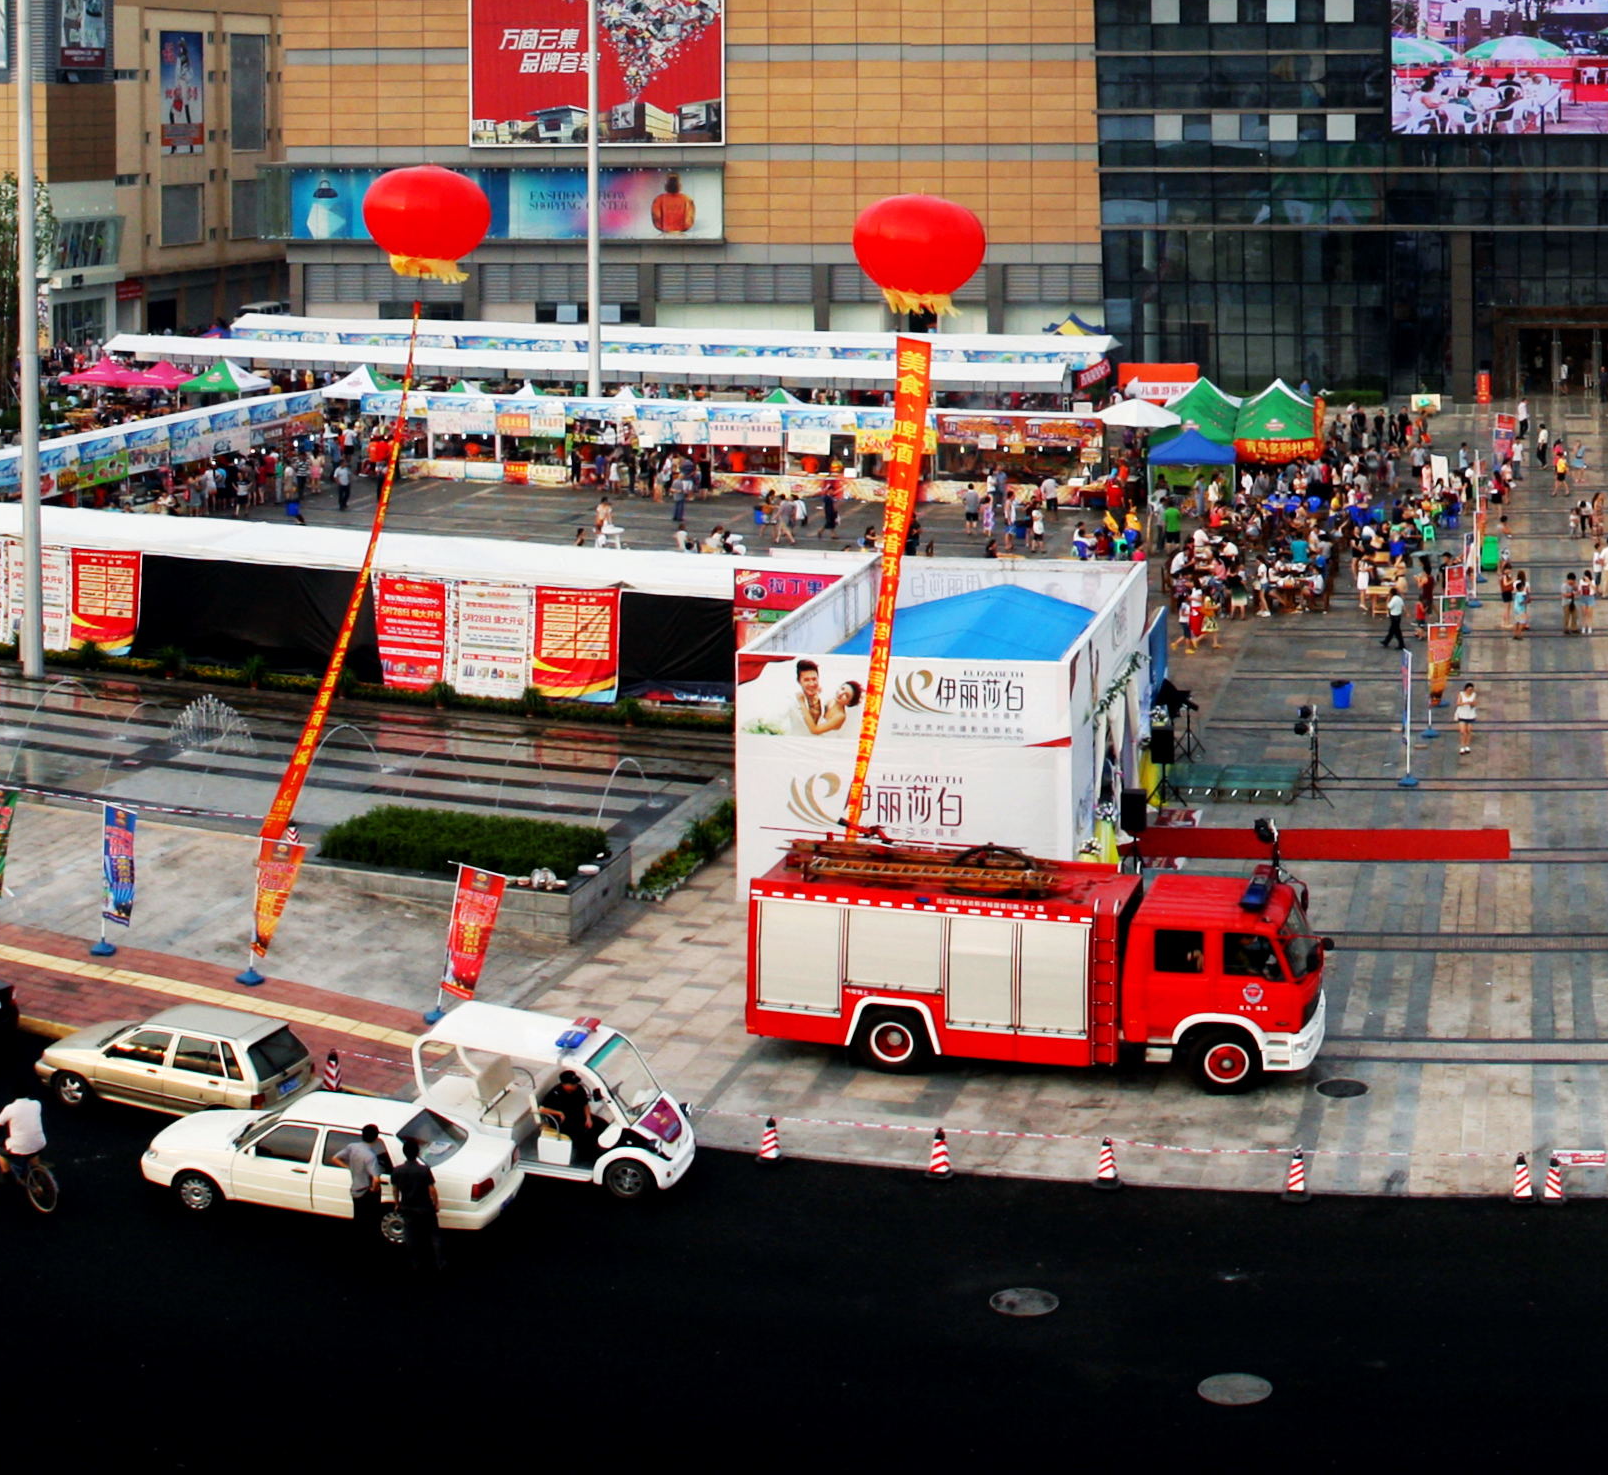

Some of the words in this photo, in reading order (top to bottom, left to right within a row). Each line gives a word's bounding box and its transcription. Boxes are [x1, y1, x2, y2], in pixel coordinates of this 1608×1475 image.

[499, 28, 581, 50] 万商云集
[584, 201, 630, 212] CNTER
[462, 614, 491, 624] 5月28日
[493, 615, 524, 627] 盛大开业
[963, 670, 1024, 678] ELIZABETH
[936, 676, 1024, 712] 伊丽莎白
[883, 774, 963, 784] ELIZABETH
